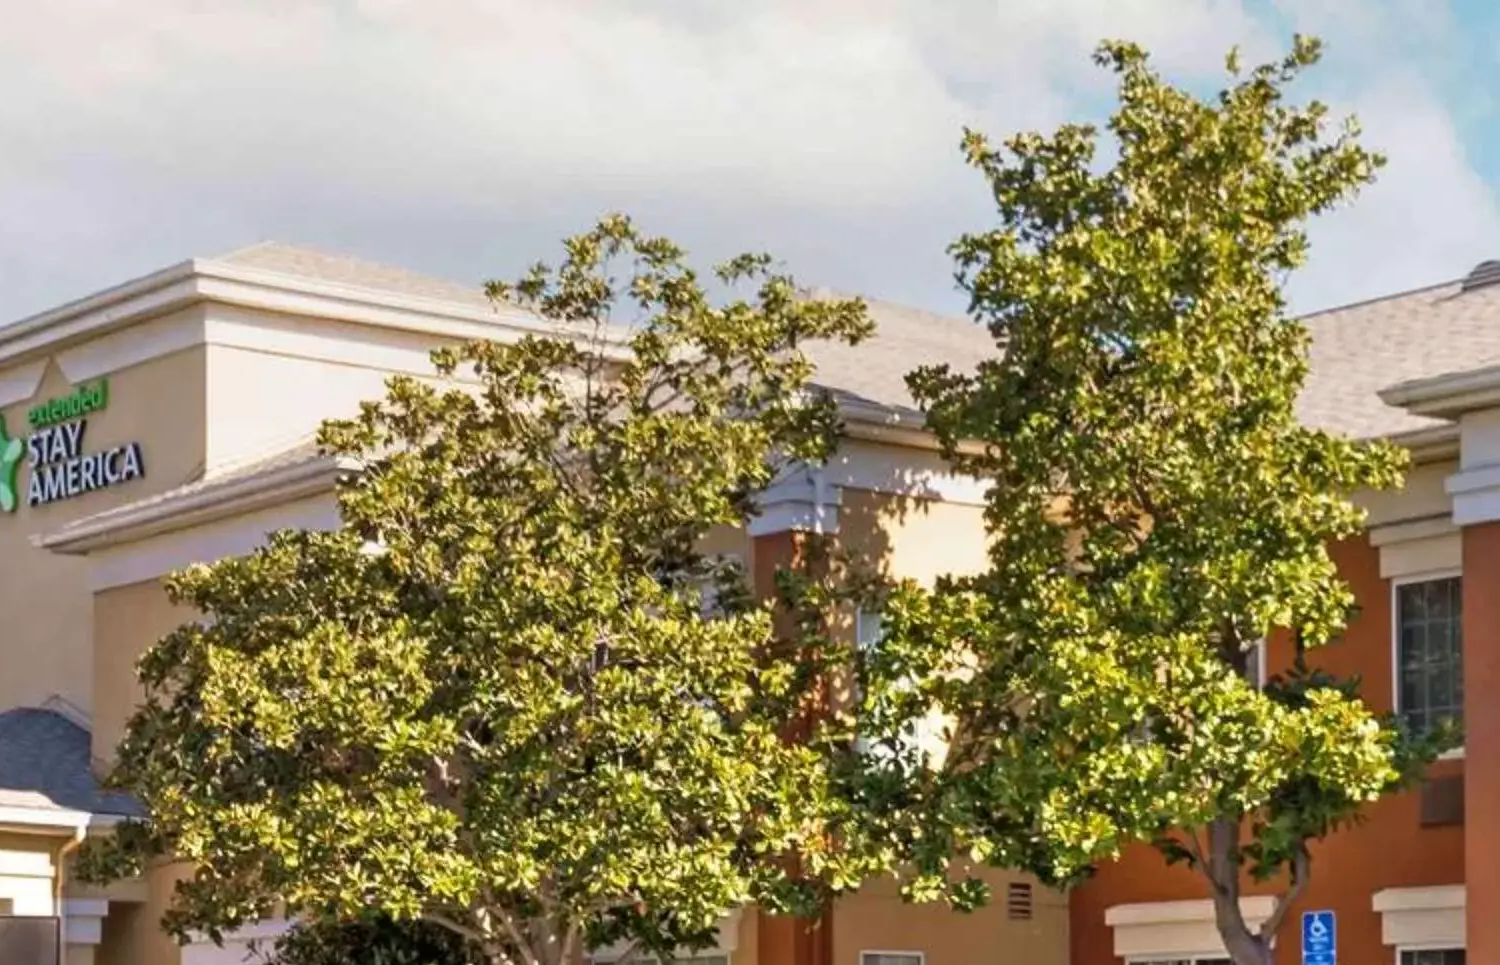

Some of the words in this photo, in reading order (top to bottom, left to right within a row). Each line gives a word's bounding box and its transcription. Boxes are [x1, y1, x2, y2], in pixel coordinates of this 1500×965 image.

[27, 377, 108, 424] extended
[27, 420, 85, 468] STAY
[27, 443, 143, 506] AMERICA
